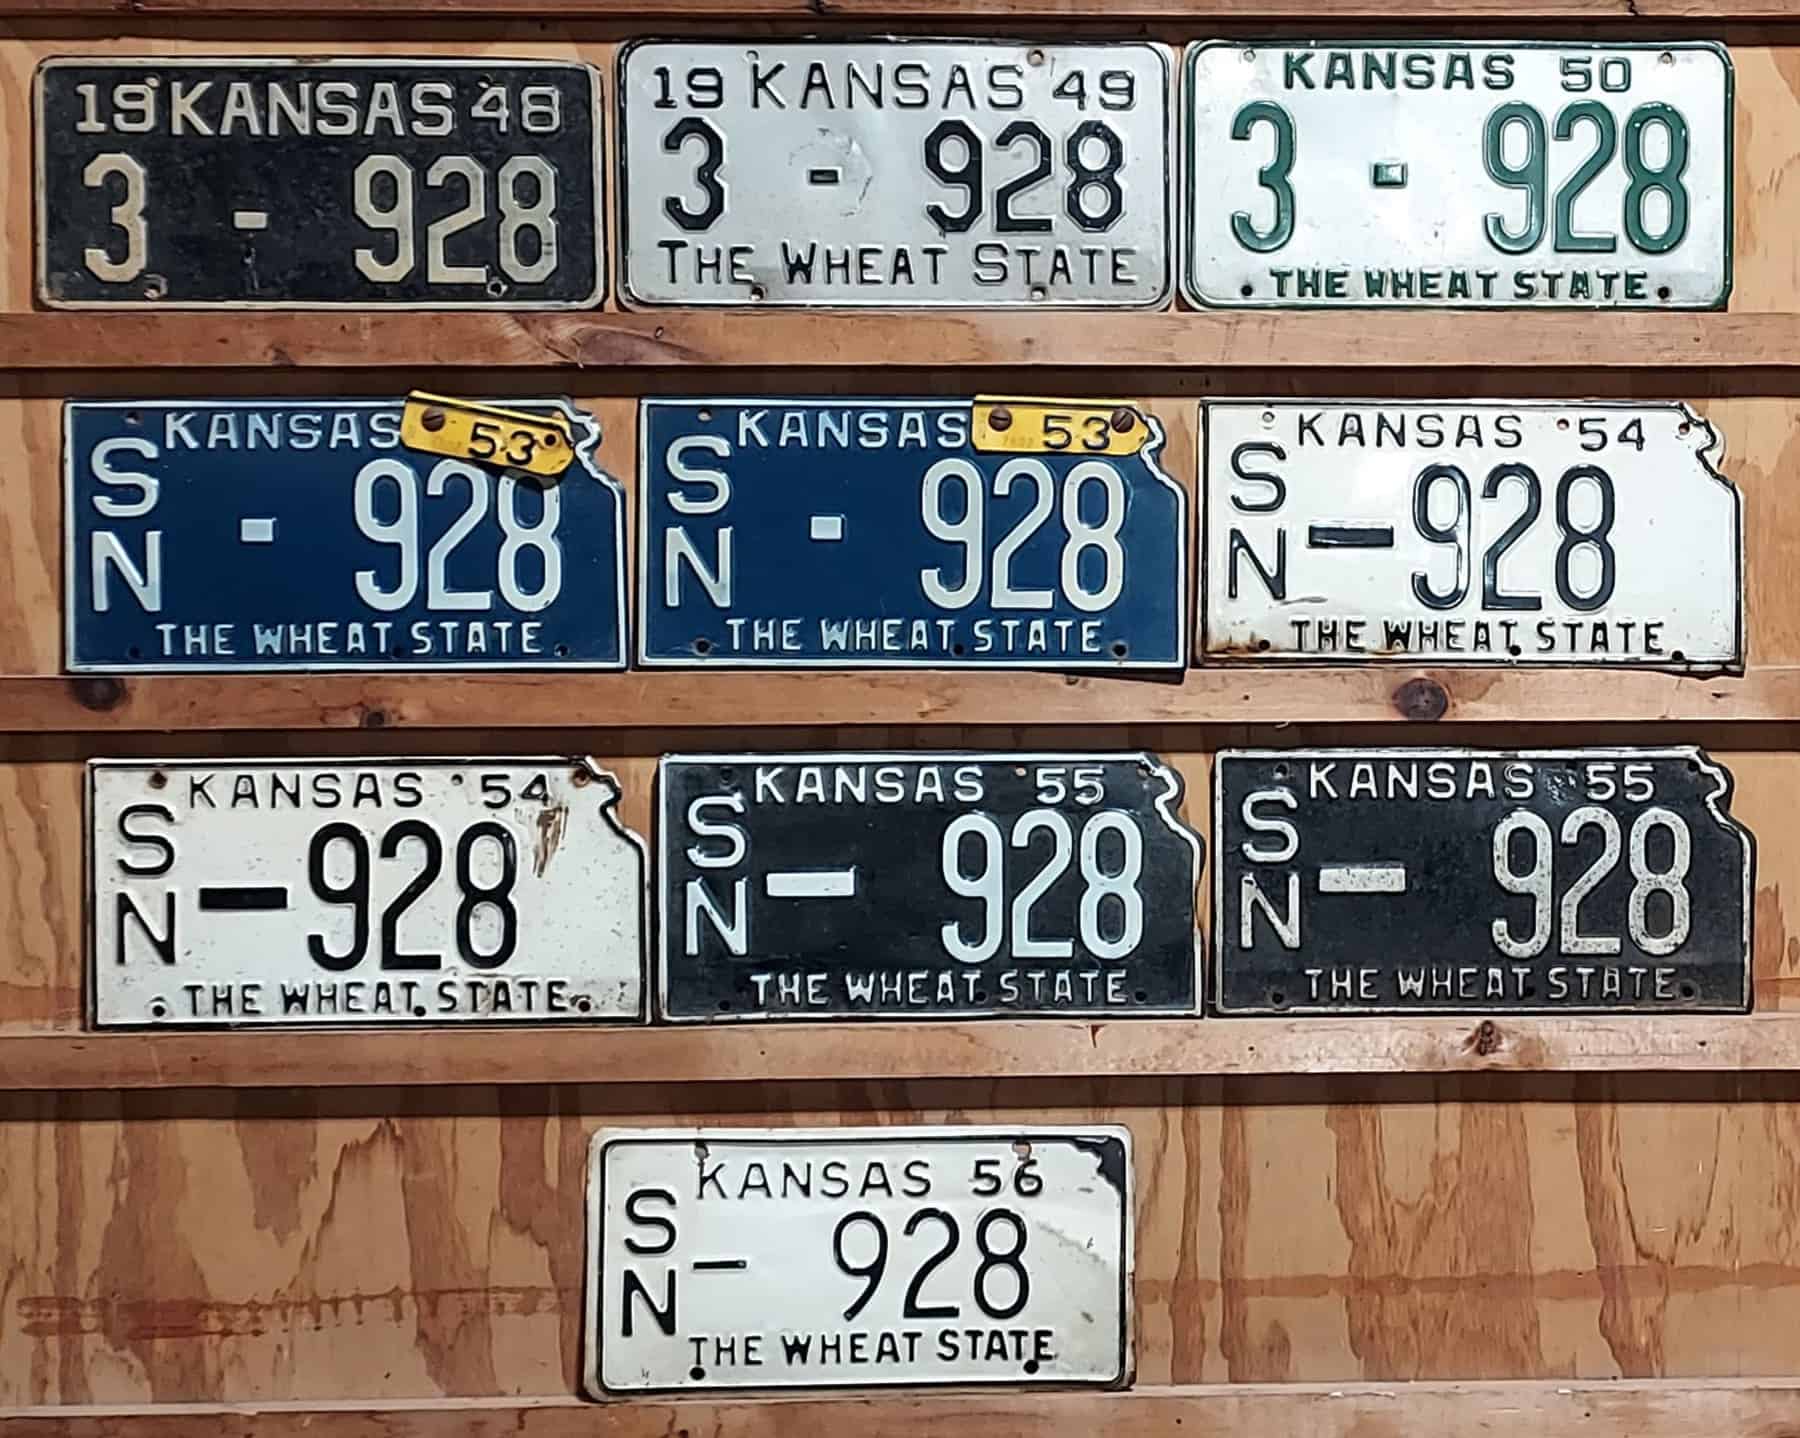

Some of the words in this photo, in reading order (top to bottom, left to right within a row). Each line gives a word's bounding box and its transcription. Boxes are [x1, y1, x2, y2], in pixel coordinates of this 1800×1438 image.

[654, 67, 724, 108] 19
[752, 63, 1024, 109] KANSAS
[1053, 70, 1135, 110] 49
[1284, 52, 1515, 89] KANSAS
[1560, 56, 1631, 92] 50
[76, 83, 156, 133] 19
[171, 81, 454, 136] KANSAS
[471, 84, 561, 132] 48
[664, 116, 727, 231] 3
[924, 119, 1124, 233] 928
[1231, 100, 1296, 253] 3
[1484, 100, 1689, 254] 928
[83, 153, 146, 282] 3
[354, 154, 557, 284] 928
[657, 240, 754, 284] THE
[781, 241, 948, 285] WHEAT
[974, 244, 1136, 285] STATE
[1270, 268, 1347, 298] THE
[1364, 269, 1497, 299] WHEAT
[1514, 270, 1647, 299] STATE
[166, 413, 400, 449] KANSAS
[468, 423, 537, 465] 53
[738, 411, 968, 448] KANSAS
[1042, 415, 1111, 451] 53
[1299, 413, 1522, 448] KANSAS
[1578, 418, 1645, 451] 54
[355, 458, 561, 612] 928
[921, 458, 1125, 612] 928
[1412, 463, 1615, 611] 928
[156, 624, 235, 655] THE
[254, 623, 393, 655] WHEAT
[411, 621, 543, 654] STATE
[726, 619, 802, 650] THE
[820, 619, 957, 651] WHEAT
[974, 619, 1102, 652] STATE
[1290, 620, 1366, 652] THE
[1383, 620, 1518, 652] WHEAT
[1536, 622, 1664, 654] STATE
[189, 774, 424, 809] KANSAS
[481, 774, 549, 808] 54
[755, 768, 985, 803] KANSAS
[1035, 768, 1104, 805] 55
[1310, 762, 1534, 799] KANSAS
[1585, 764, 1655, 801] 55
[308, 820, 517, 972] 928
[941, 809, 1143, 963] 928
[1492, 807, 1691, 958] 928
[183, 984, 262, 1016] THE
[280, 982, 418, 1015] WHEAT
[437, 981, 568, 1013] STATE
[750, 973, 829, 1005] THE
[846, 972, 981, 1004] WHEAT
[1000, 970, 1128, 1003] STATE
[1304, 969, 1378, 999] THE
[1398, 968, 1530, 999] WHEAT
[1548, 967, 1676, 998] STATE
[699, 1161, 932, 1199] KANSAS
[973, 1160, 1043, 1197] 56
[833, 1208, 1030, 1321] 928
[689, 1336, 763, 1368] THE
[781, 1333, 923, 1365] WHEAT
[936, 1329, 1055, 1363] STATE
